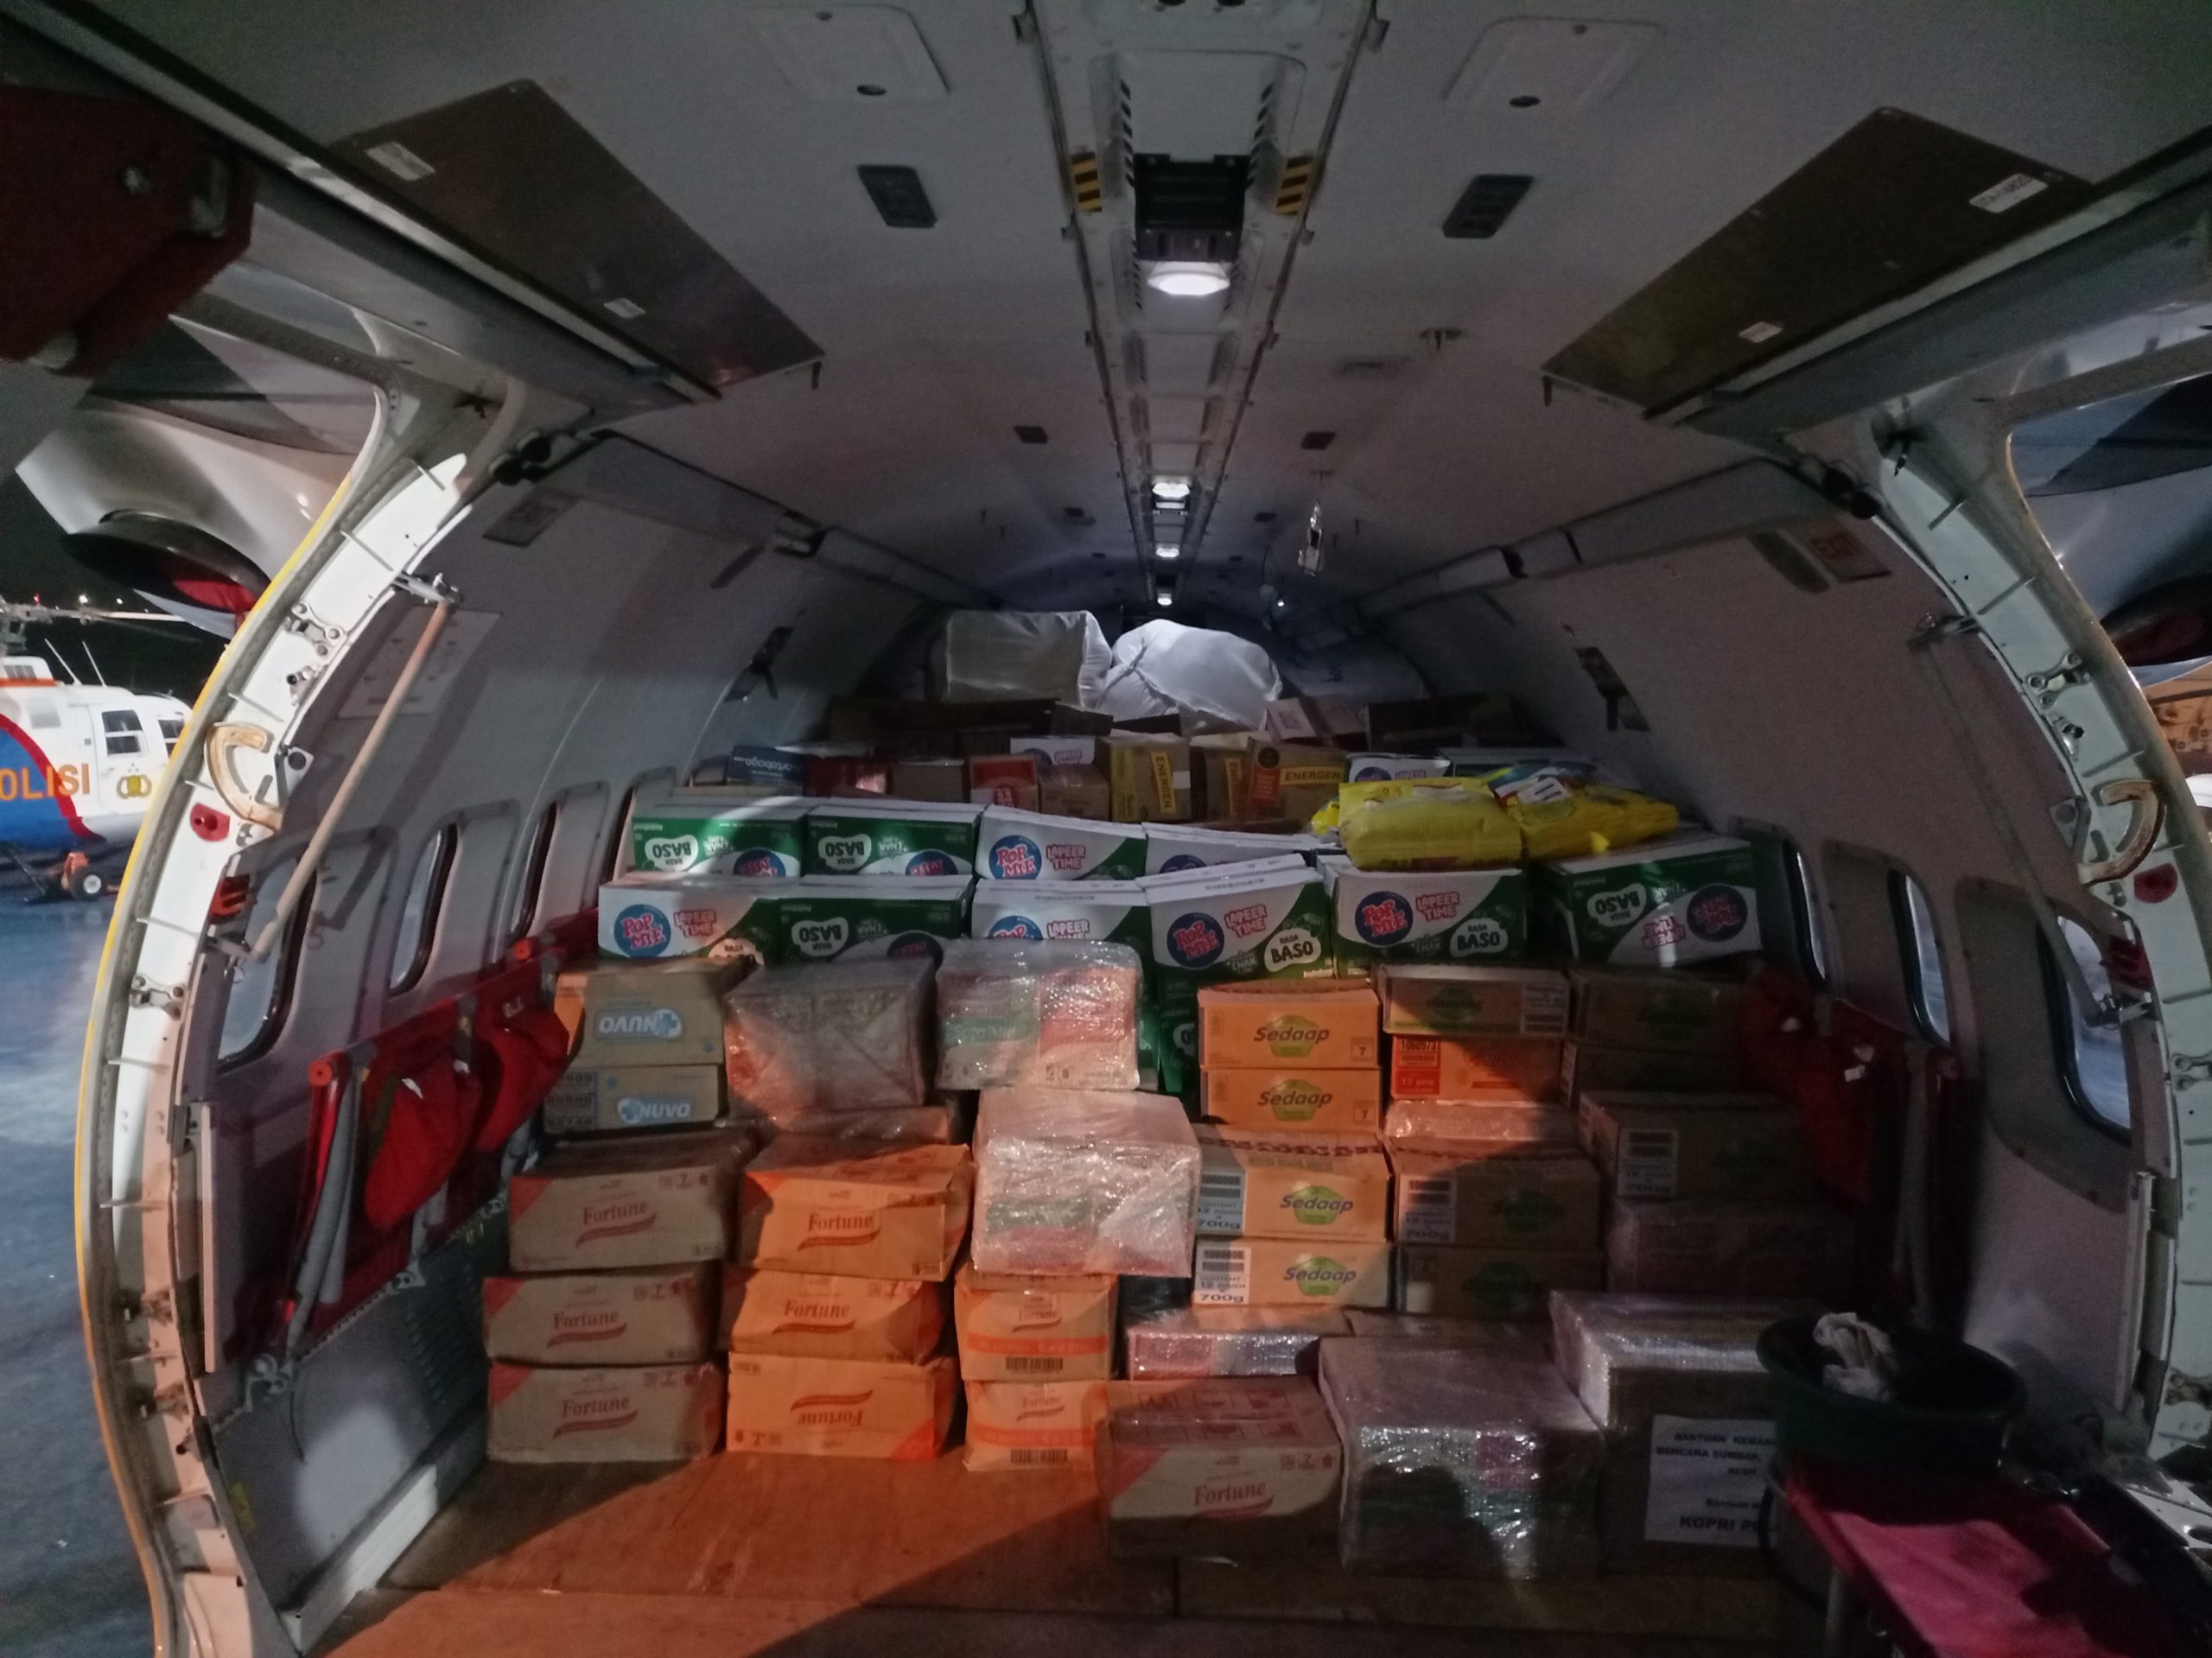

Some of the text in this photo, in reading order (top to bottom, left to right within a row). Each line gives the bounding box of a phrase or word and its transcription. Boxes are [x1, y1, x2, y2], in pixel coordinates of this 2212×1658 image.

[1285, 770, 1342, 782] ENERGEN
[652, 842, 691, 858] BASO
[825, 840, 865, 855] BASO
[996, 844, 1027, 866] POP
[1051, 857, 1083, 870] TIME
[1595, 891, 1640, 915] BASO
[1224, 904, 1267, 930] LAPEER
[1421, 905, 1458, 922] TIME
[622, 913, 654, 937] POP
[798, 924, 842, 941] BASO
[1231, 916, 1267, 938] TIME
[630, 925, 665, 950] MIE
[1457, 931, 1501, 950] BASO
[1270, 940, 1314, 964] BASO
[599, 1015, 657, 1034] NUVO
[1254, 1026, 1330, 1046] Sedaap
[1257, 1089, 1332, 1109] Sedaap
[640, 1102, 690, 1118] NUVO
[582, 1200, 648, 1225] Fortune
[1280, 1195, 1353, 1214] Sedaap
[807, 1212, 874, 1231] Fortune
[1198, 1219, 1241, 1229] 700g
[1283, 1267, 1357, 1285] Sedaap
[1200, 1294, 1244, 1303] 700g
[783, 1299, 850, 1318] Fortune
[554, 1309, 620, 1329] Fortune
[561, 1394, 631, 1417] Fortune
[798, 1408, 863, 1426] Fortune
[1194, 1482, 1268, 1505] Fortune
[1680, 1515, 1735, 1530] KOPRI
